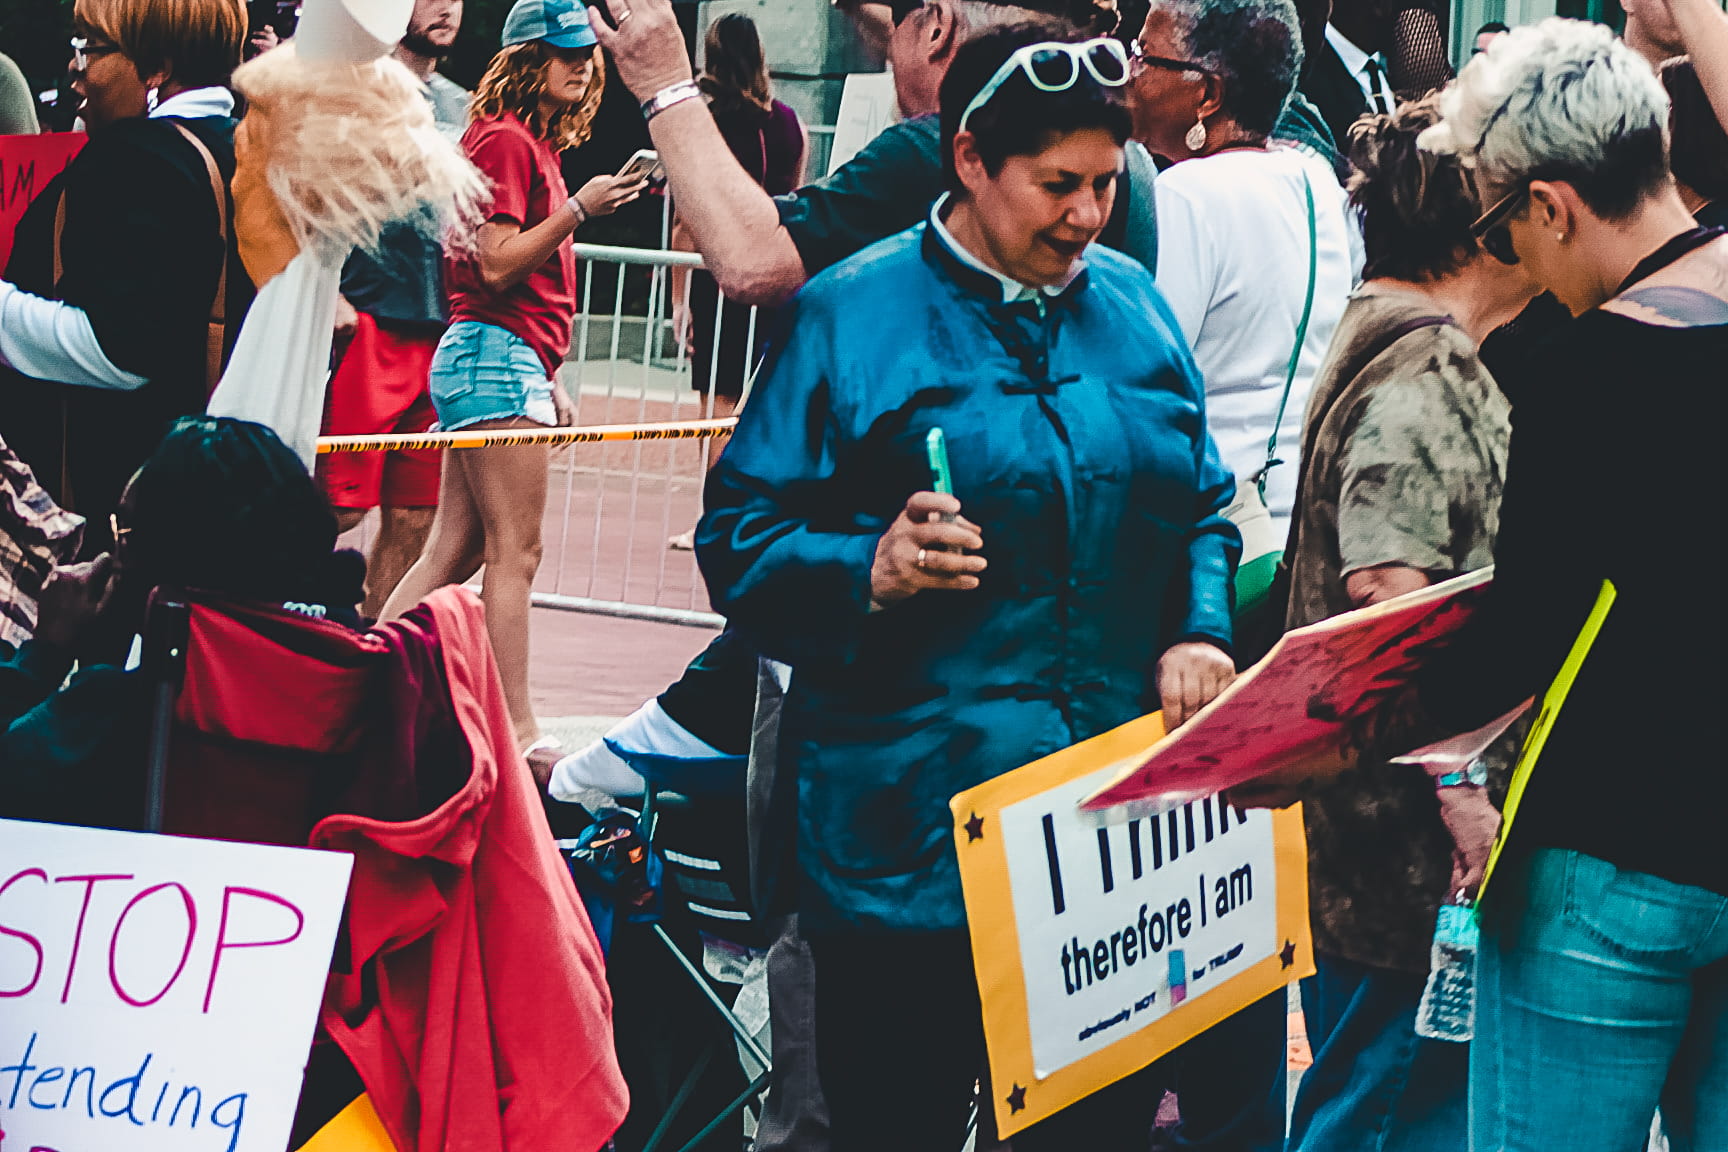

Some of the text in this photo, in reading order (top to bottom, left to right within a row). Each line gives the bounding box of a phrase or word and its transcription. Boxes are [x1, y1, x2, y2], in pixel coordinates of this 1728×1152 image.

[1041, 812, 1066, 916] I
[1060, 863, 1253, 996] therefore I am
[0, 867, 304, 1014] STOP
